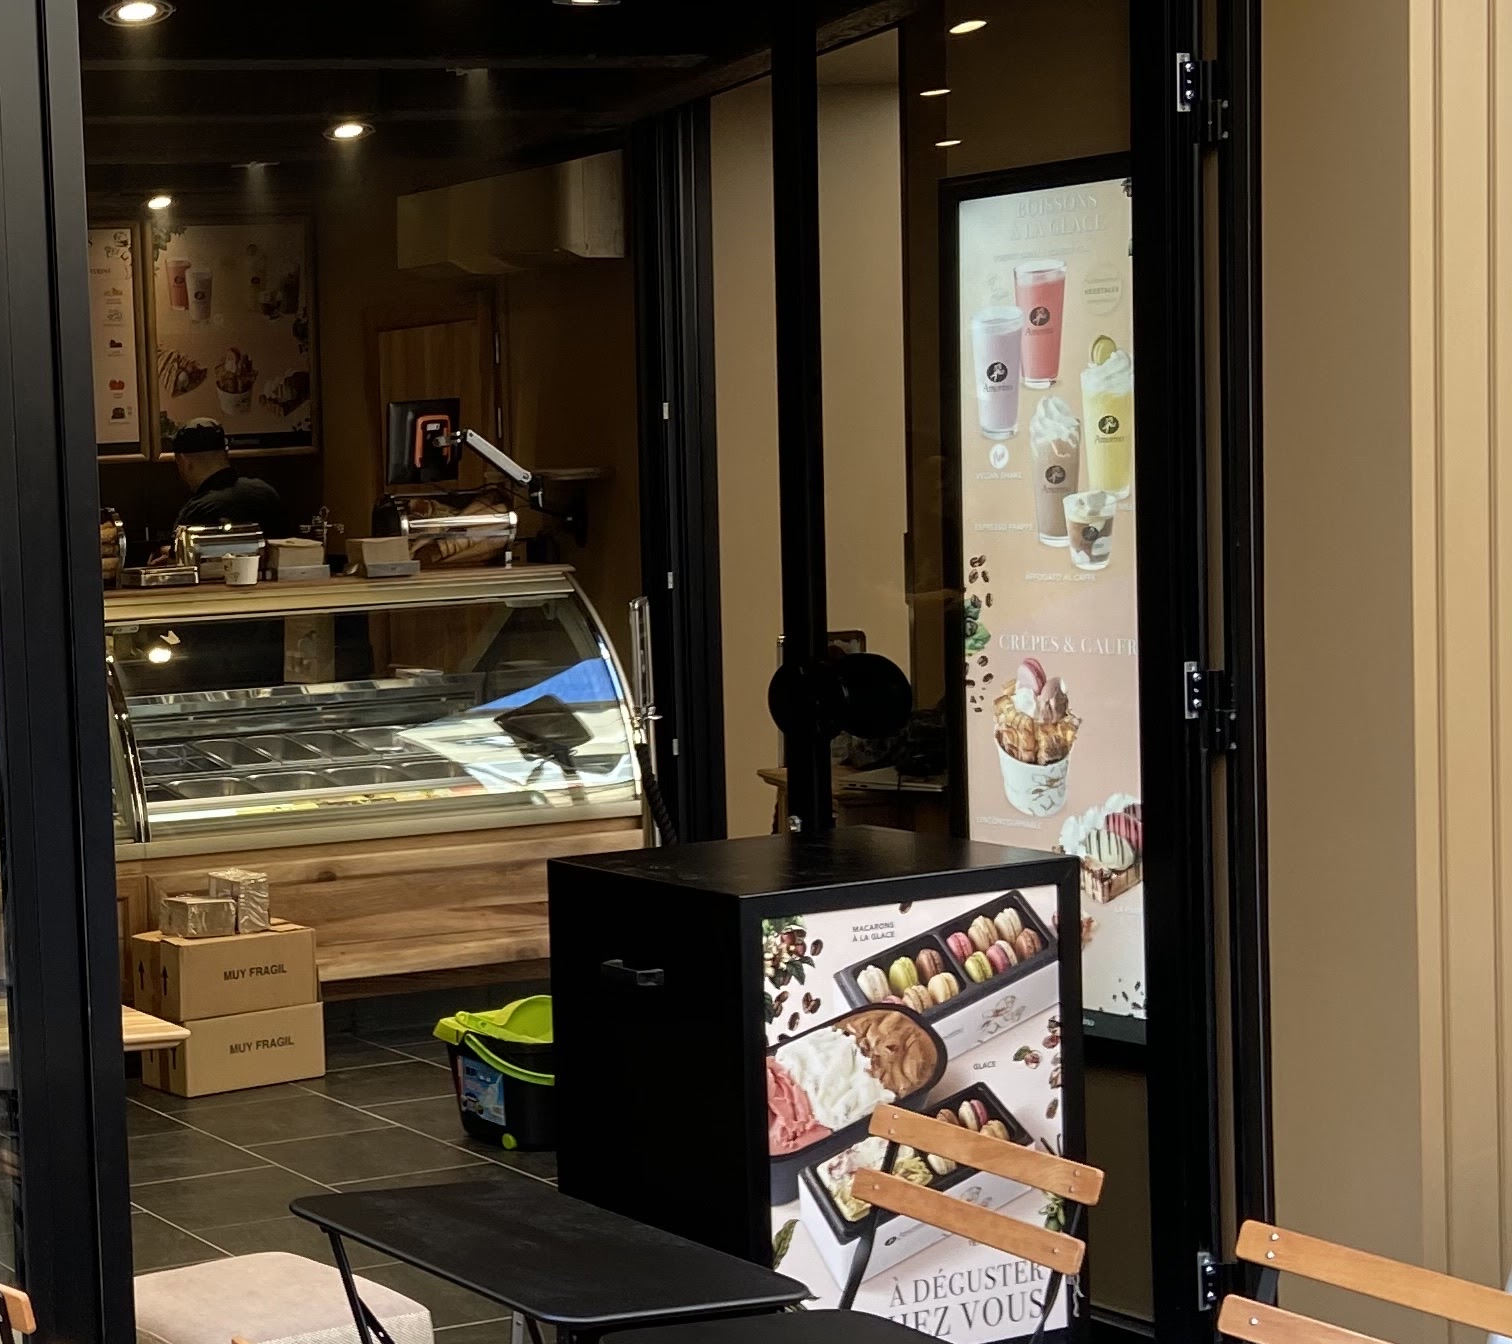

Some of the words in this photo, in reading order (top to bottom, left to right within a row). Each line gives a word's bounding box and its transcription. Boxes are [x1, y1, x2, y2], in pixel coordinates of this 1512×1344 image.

[1063, 637, 1076, 653] &
[1081, 637, 1137, 655] GAUFR
[852, 921, 895, 933] MACARONS
[852, 933, 858, 943] À
[860, 933, 870, 942] LA
[871, 930, 895, 939] GLACE
[223, 968, 247, 981] MUY
[249, 963, 288, 978] FRAGIL
[229, 1041, 253, 1055] MUY
[255, 1035, 295, 1050] FRAGIL
[973, 1060, 996, 1070] GLACE
[890, 1277, 906, 1307] À
[913, 1260, 1044, 1303] DÉGUSTER
[960, 1288, 1044, 1331] VOUS
